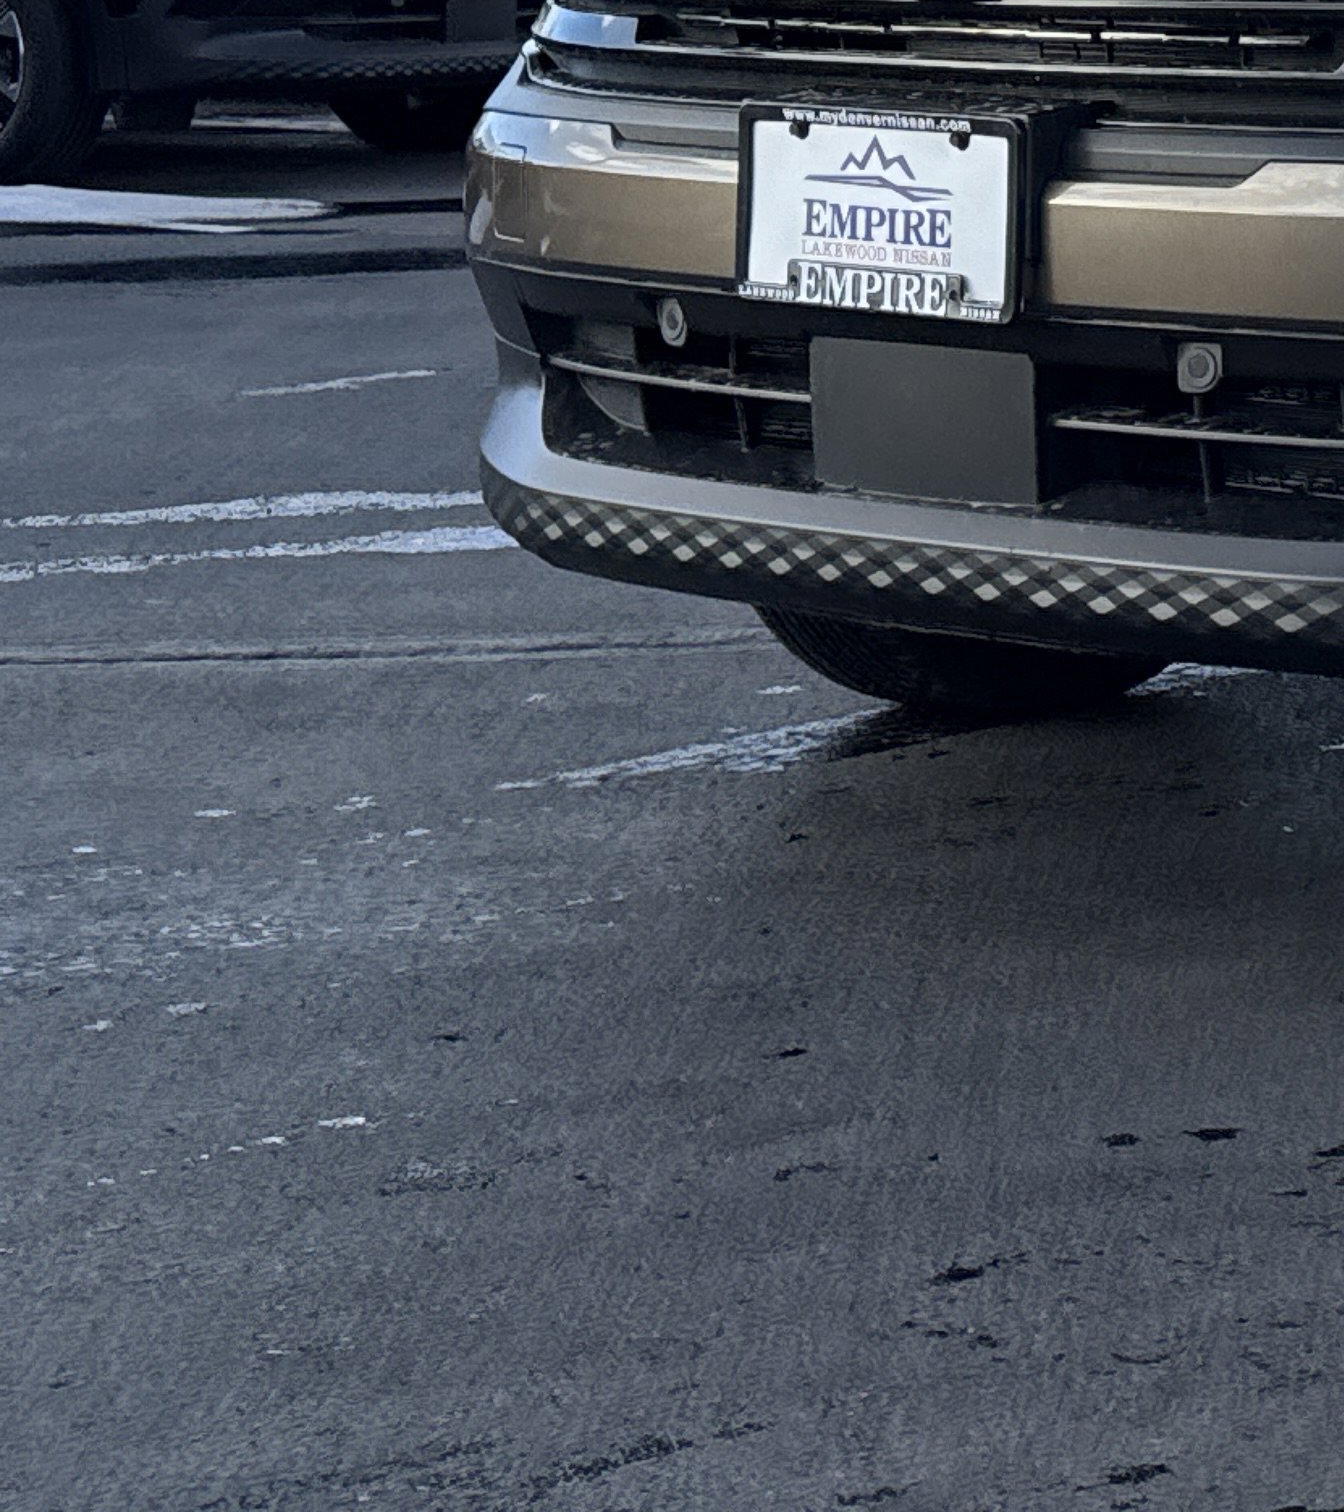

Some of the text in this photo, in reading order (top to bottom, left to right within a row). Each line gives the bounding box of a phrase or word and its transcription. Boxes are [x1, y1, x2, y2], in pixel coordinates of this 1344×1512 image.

[782, 107, 972, 133] www.mydenvernissan.com
[801, 198, 952, 249] EMPIRE
[801, 239, 952, 268] LAKEWOOD NISSAN
[796, 262, 948, 317] EMPIRE
